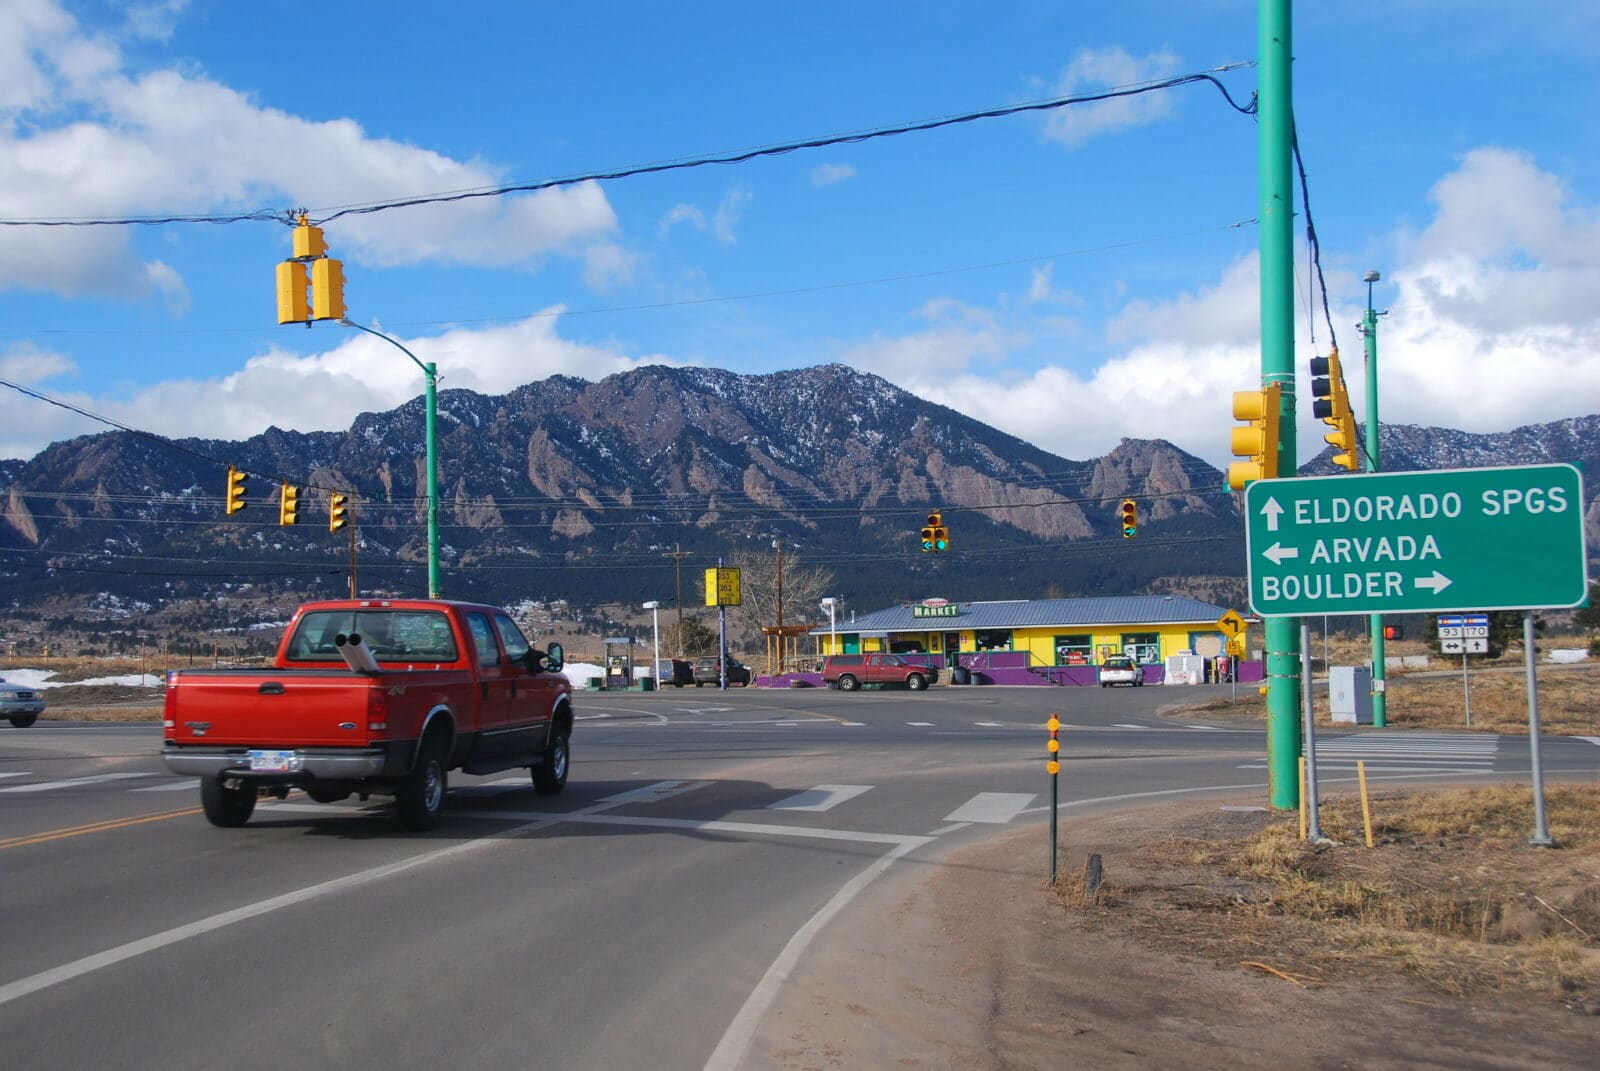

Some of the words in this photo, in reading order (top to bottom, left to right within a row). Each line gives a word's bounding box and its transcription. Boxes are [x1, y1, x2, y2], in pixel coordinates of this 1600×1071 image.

[1295, 491, 1462, 524] ELDORADO
[1481, 487, 1568, 516] SPGS
[1310, 534, 1442, 564] ARVADA
[1262, 572, 1403, 600] BOULDER
[914, 606, 957, 617] MARKET
[1443, 627, 1458, 636] 93
[1466, 626, 1486, 635] 170
